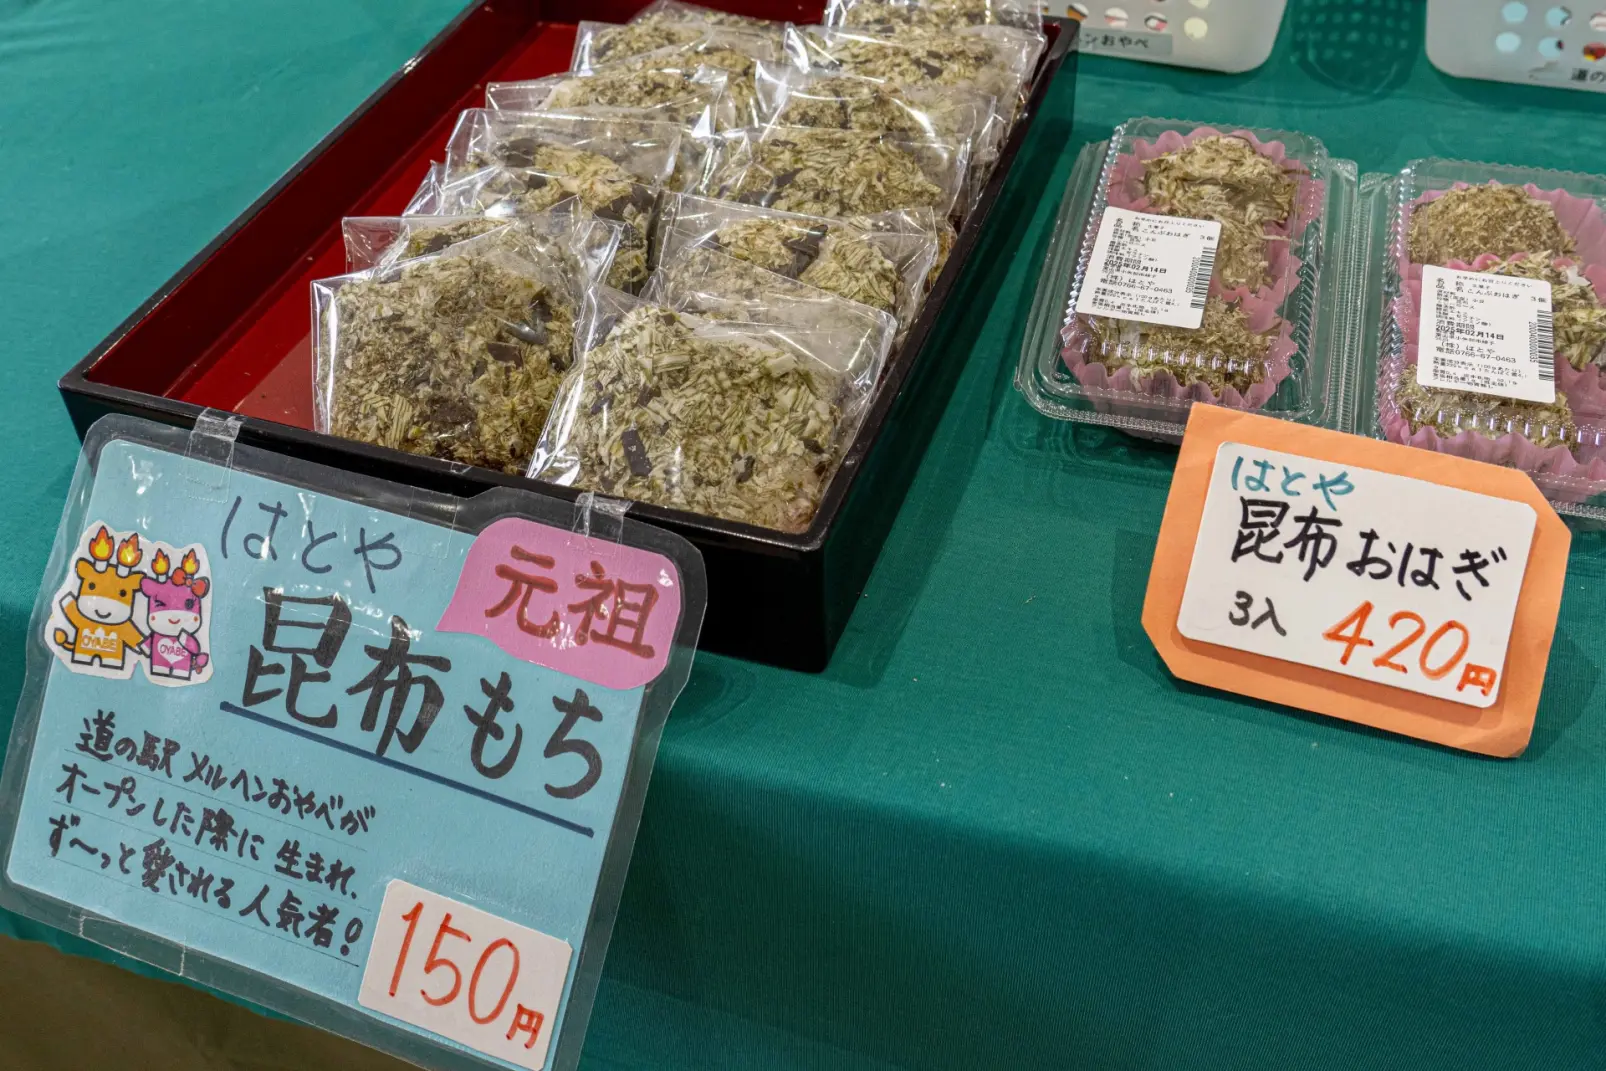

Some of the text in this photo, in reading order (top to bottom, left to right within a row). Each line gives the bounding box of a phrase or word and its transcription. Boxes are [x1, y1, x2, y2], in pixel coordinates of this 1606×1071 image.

[1079, 34, 1149, 48] ンおやべ
[1231, 456, 1355, 511] はとや
[219, 495, 402, 594] はとや
[1231, 496, 1507, 601] 昆布おはぎ
[81, 634, 118, 651] OYABE
[160, 645, 188, 657] OYABE
[485, 545, 661, 660] 元祖
[1228, 590, 1498, 697] 3入 420円
[243, 586, 604, 799] 昆布もち
[388, 902, 547, 1050] 150円
